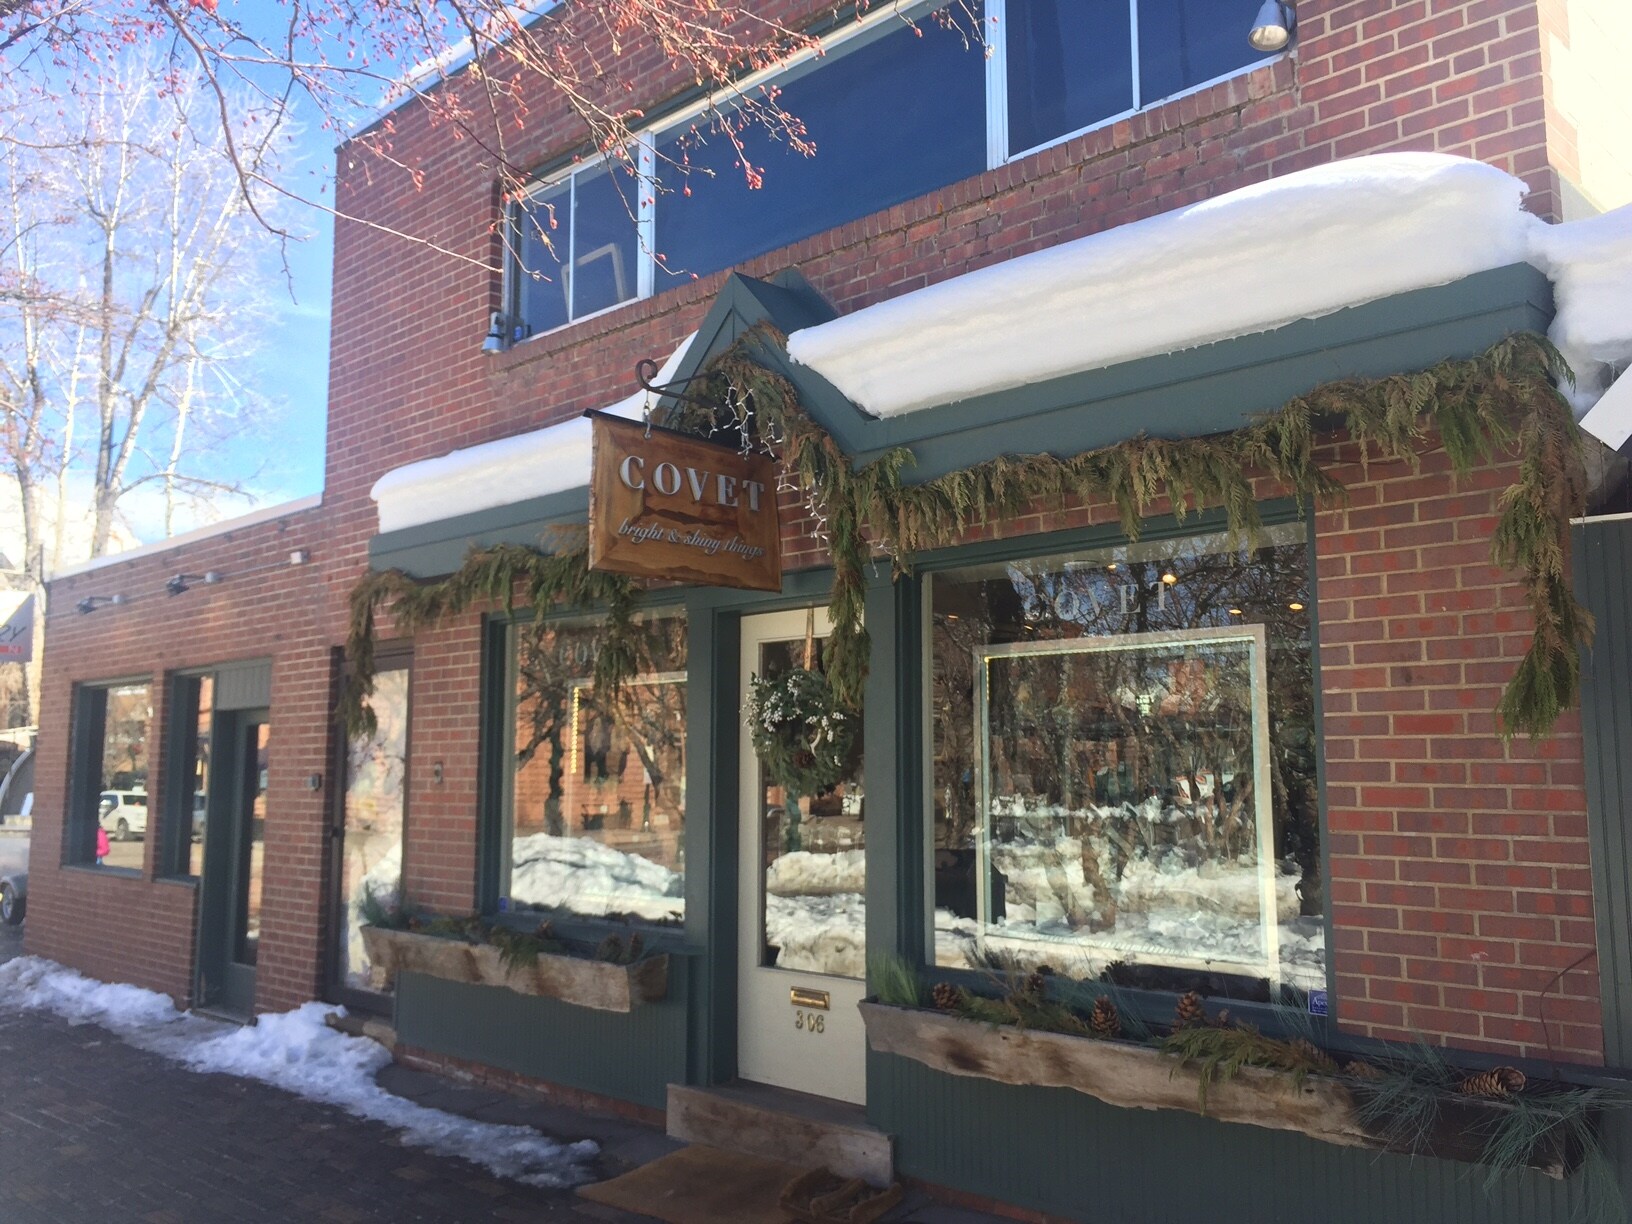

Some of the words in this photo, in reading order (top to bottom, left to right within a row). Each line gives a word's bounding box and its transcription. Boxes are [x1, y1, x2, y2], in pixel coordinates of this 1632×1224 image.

[618, 454, 765, 512] COVET
[618, 517, 664, 544] bright
[668, 527, 681, 544] &
[683, 527, 722, 556] shiny
[723, 535, 765, 561] things
[795, 1009, 825, 1033] 306
